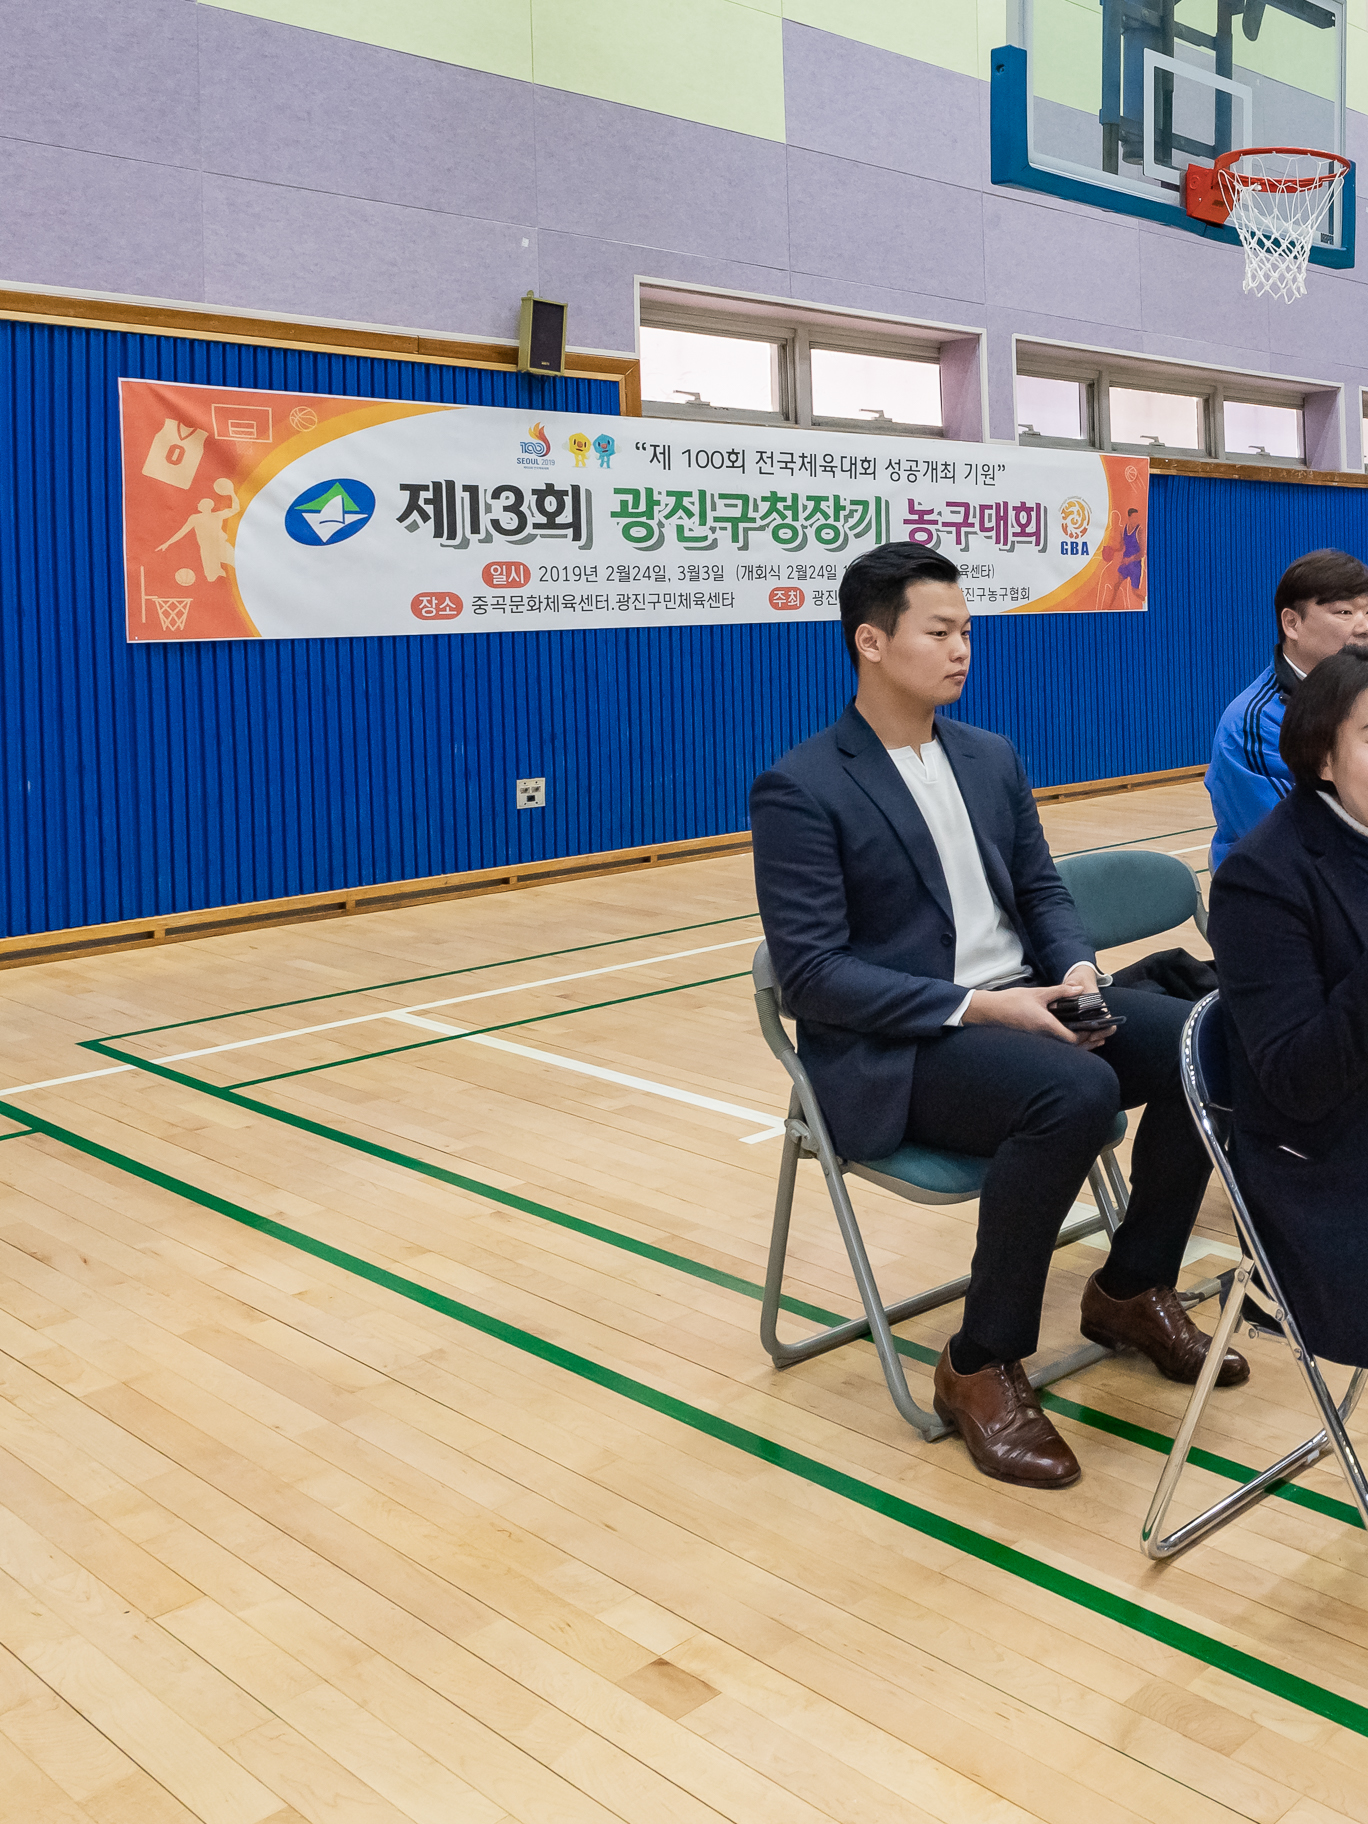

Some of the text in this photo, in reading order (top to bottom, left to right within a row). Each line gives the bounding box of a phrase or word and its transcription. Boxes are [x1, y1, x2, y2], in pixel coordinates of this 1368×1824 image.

[516, 457, 556, 466] SEOUL 2019
[682, 448, 746, 475] 100회
[755, 450, 876, 479] 전국체육대회
[885, 462, 956, 485] 성공개최
[397, 479, 1042, 547] 제13회 광진구청장기 농구대회
[1060, 540, 1090, 556] GBA
[489, 563, 995, 585] 일시 2019년 2월24일, 3월3일 (개회식 2월24일 육센타)
[418, 595, 458, 617] 장소
[772, 588, 801, 608] 주최
